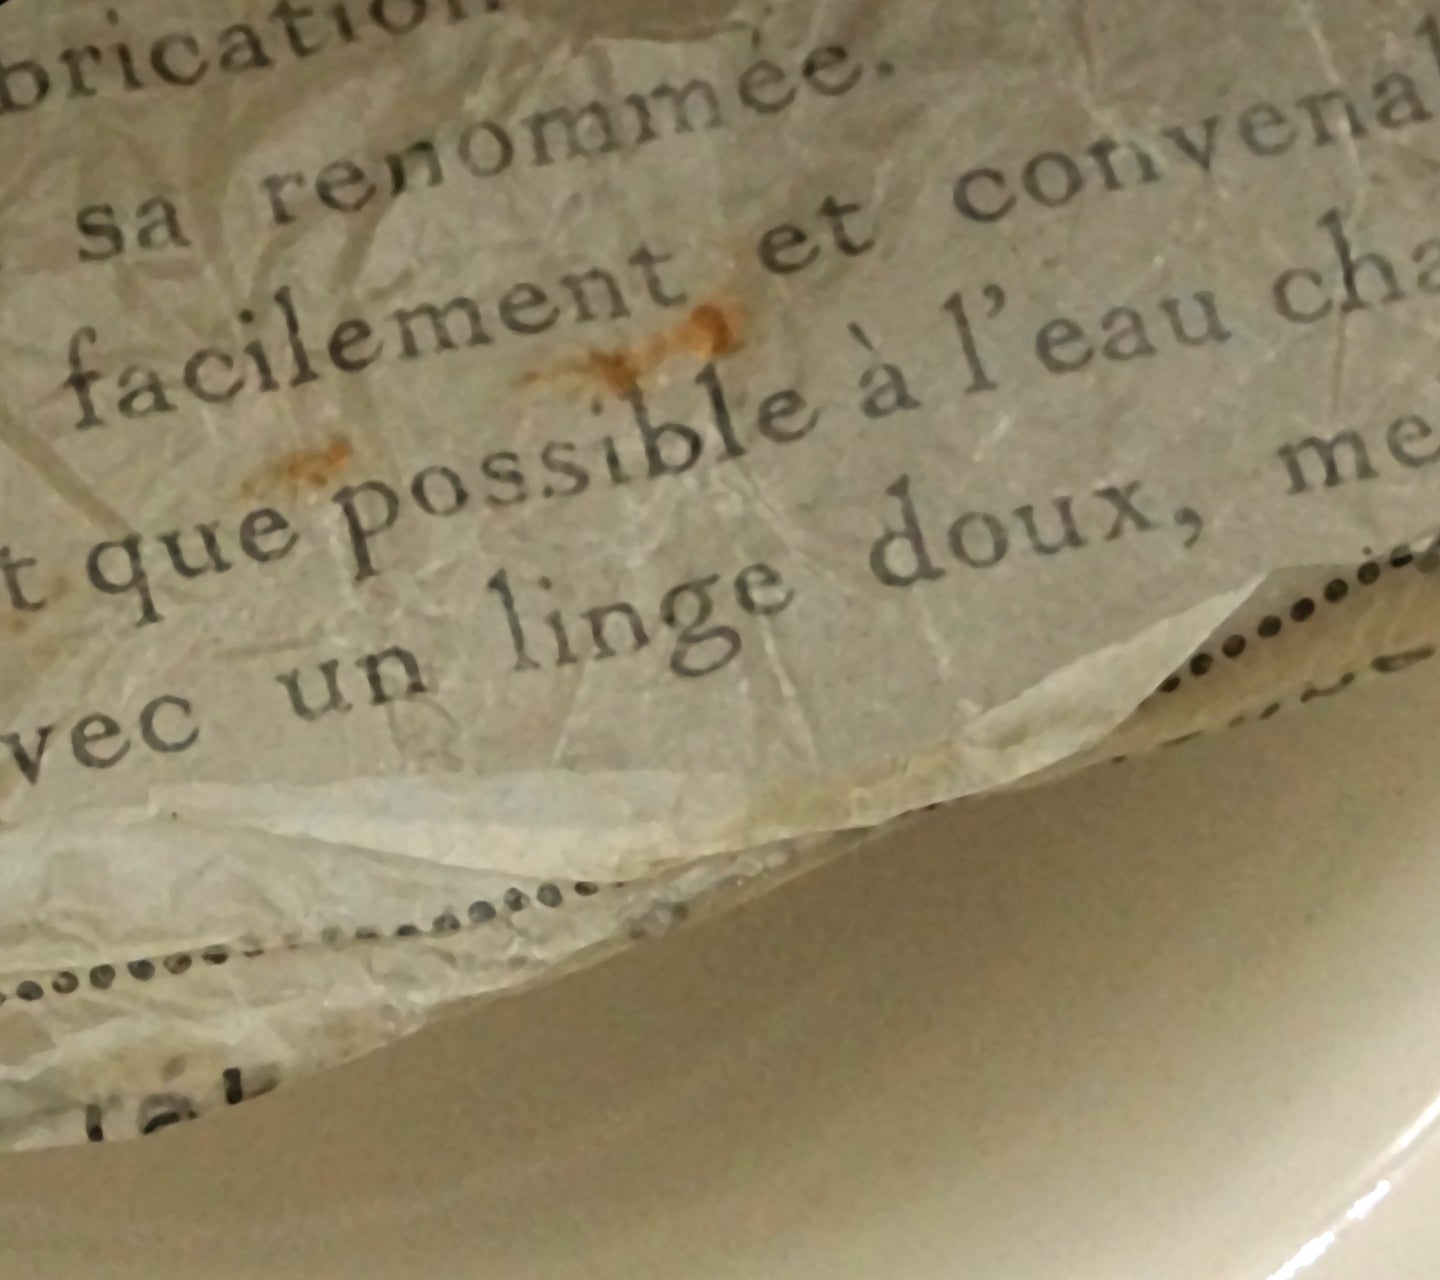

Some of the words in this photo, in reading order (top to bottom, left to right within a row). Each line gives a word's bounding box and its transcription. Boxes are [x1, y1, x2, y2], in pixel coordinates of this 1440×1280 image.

[74, 192, 190, 263] sa
[259, 2, 895, 227] renommée.
[63, 241, 688, 434] facilement
[753, 192, 880, 277] et
[83, 501, 301, 629] que
[331, 360, 822, 581] possible
[847, 319, 922, 421] à
[275, 642, 430, 727] un
[489, 560, 797, 680] linge
[865, 472, 1207, 590] doux,
